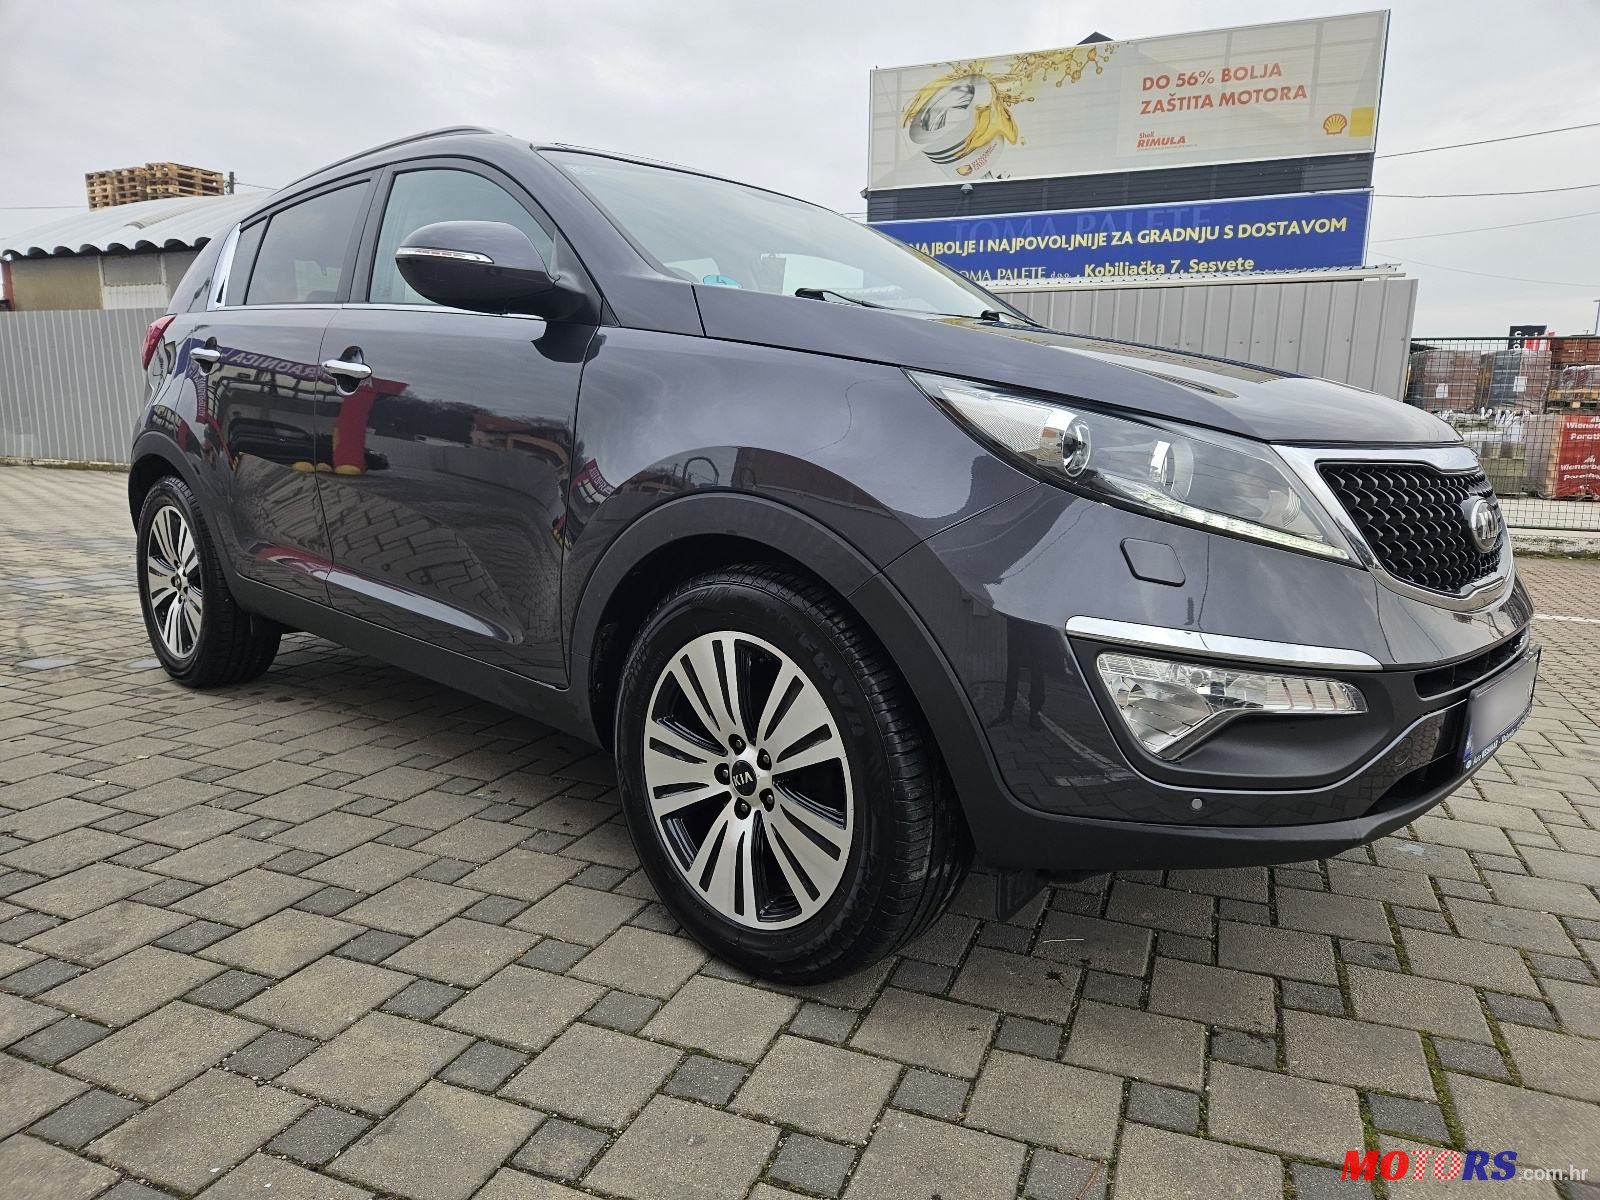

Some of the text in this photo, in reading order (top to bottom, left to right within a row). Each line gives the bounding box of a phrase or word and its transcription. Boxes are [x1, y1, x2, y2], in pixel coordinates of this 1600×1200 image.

[1142, 63, 1282, 91] DO 56% BOLJA
[1140, 85, 1307, 115] ZAŠTITA MOTORA
[1136, 136, 1186, 148] RIMULA
[979, 239, 984, 252] I
[988, 232, 1107, 254] NAJPOVOLJNIJE
[1111, 231, 1133, 245] ZA
[1137, 225, 1219, 244] GRADNJU
[1223, 224, 1234, 238] S
[1238, 217, 1347, 238] DOSTAVOM
[998, 267, 1046, 280] PALETE
[1189, 257, 1254, 273] Sesvete
[733, 772, 753, 786] KIA
